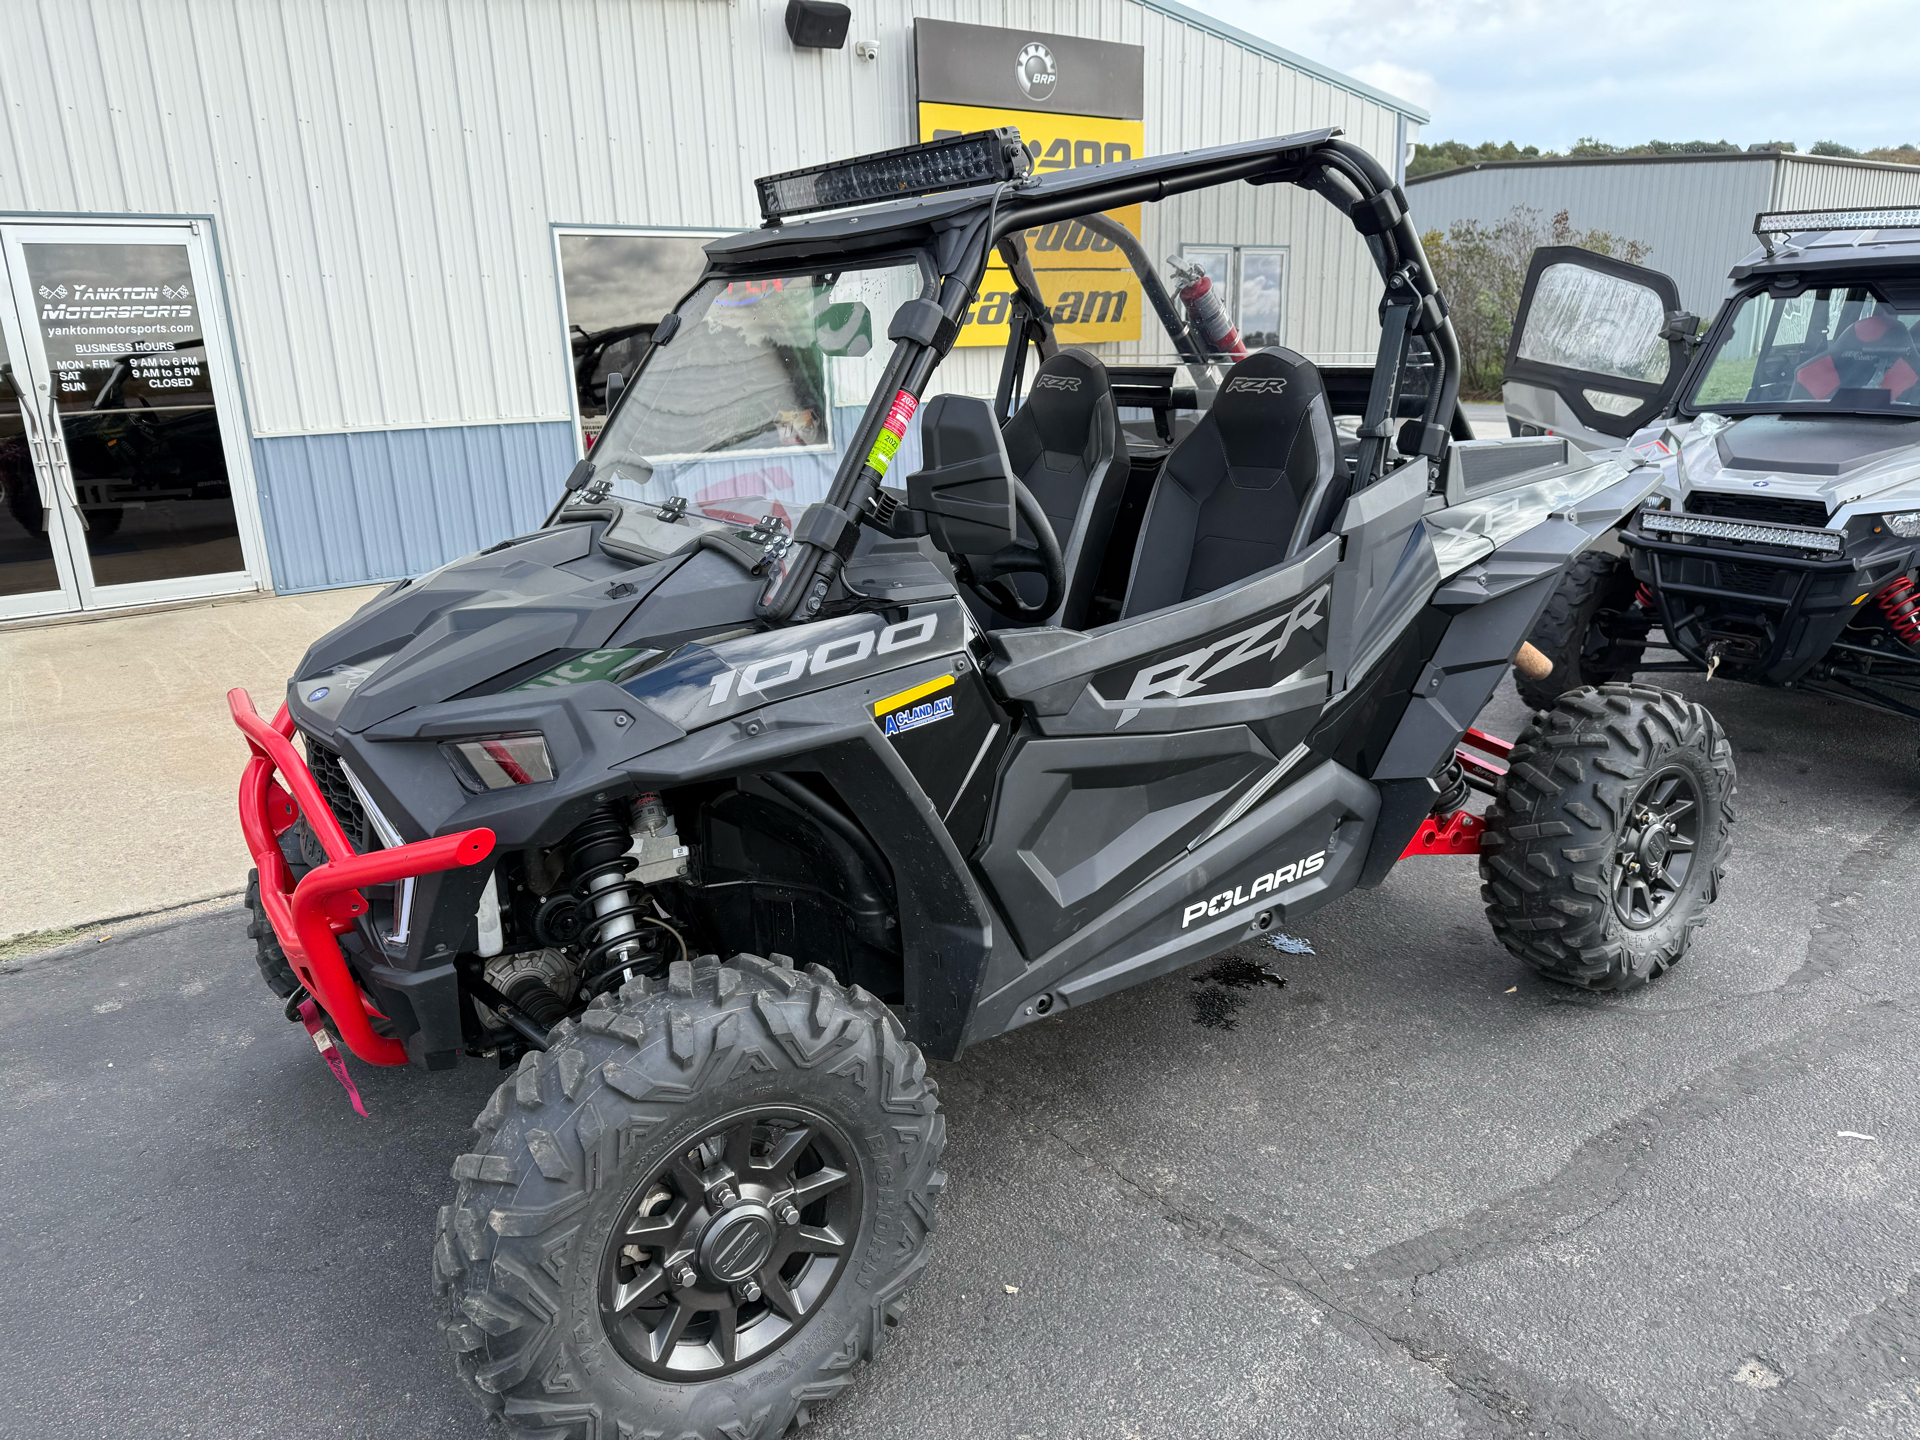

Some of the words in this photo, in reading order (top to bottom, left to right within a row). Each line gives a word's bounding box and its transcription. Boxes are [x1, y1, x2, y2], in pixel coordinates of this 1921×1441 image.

[1032, 73, 1056, 85] BRP
[72, 284, 159, 300] YANKTON
[41, 303, 193, 320] MOTORSPORTS
[47, 323, 194, 338] yanktonmotorsports.com
[75, 342, 133, 353] BUSINESS
[135, 341, 175, 352] HOURS
[56, 360, 84, 370] MON
[92, 359, 111, 369] FRI
[130, 358, 138, 368] 9
[140, 358, 158, 368] AM
[160, 357, 170, 367] to
[172, 357, 180, 366] 6
[181, 356, 198, 366] PM
[59, 371, 82, 381] SAT
[132, 369, 140, 379] 9
[142, 368, 160, 378] AM
[162, 368, 172, 377] to
[175, 367, 182, 377] 5
[183, 367, 201, 377] PM
[61, 382, 87, 393] SUN
[149, 378, 194, 388] CLOSED
[1036, 375, 1082, 392] RZR
[1225, 376, 1288, 394] RZR
[900, 394, 916, 410] 2024
[1438, 498, 1520, 554] XP
[708, 614, 938, 707] 1000
[1113, 583, 1331, 731] RZR
[933, 695, 953, 715] ATV
[1181, 850, 1326, 929] POLARIS
[855, 1133, 895, 1290] BIGHORN
